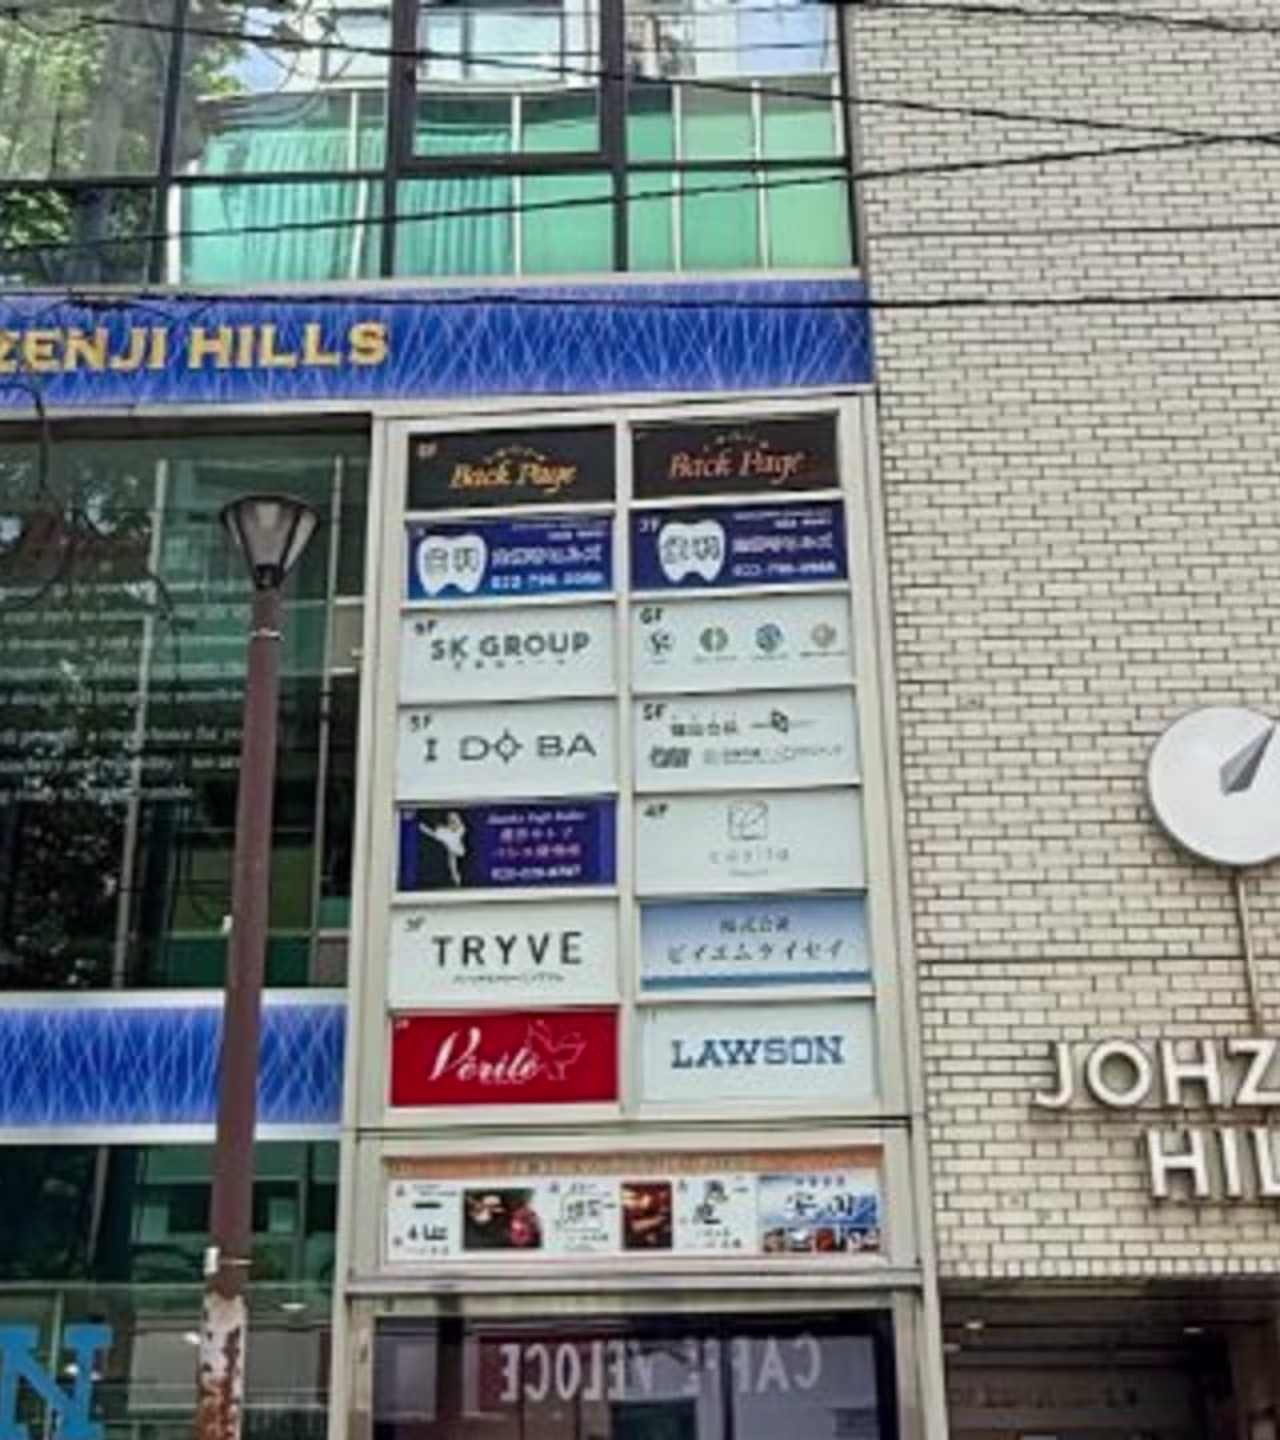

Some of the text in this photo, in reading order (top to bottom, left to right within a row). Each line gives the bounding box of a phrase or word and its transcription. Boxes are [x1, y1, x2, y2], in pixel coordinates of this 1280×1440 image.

[187, 322, 388, 371] HILLS
[430, 631, 590, 662] SK GROUP
[431, 930, 584, 968] TRYVE
[671, 1034, 845, 1070] LAWSON
